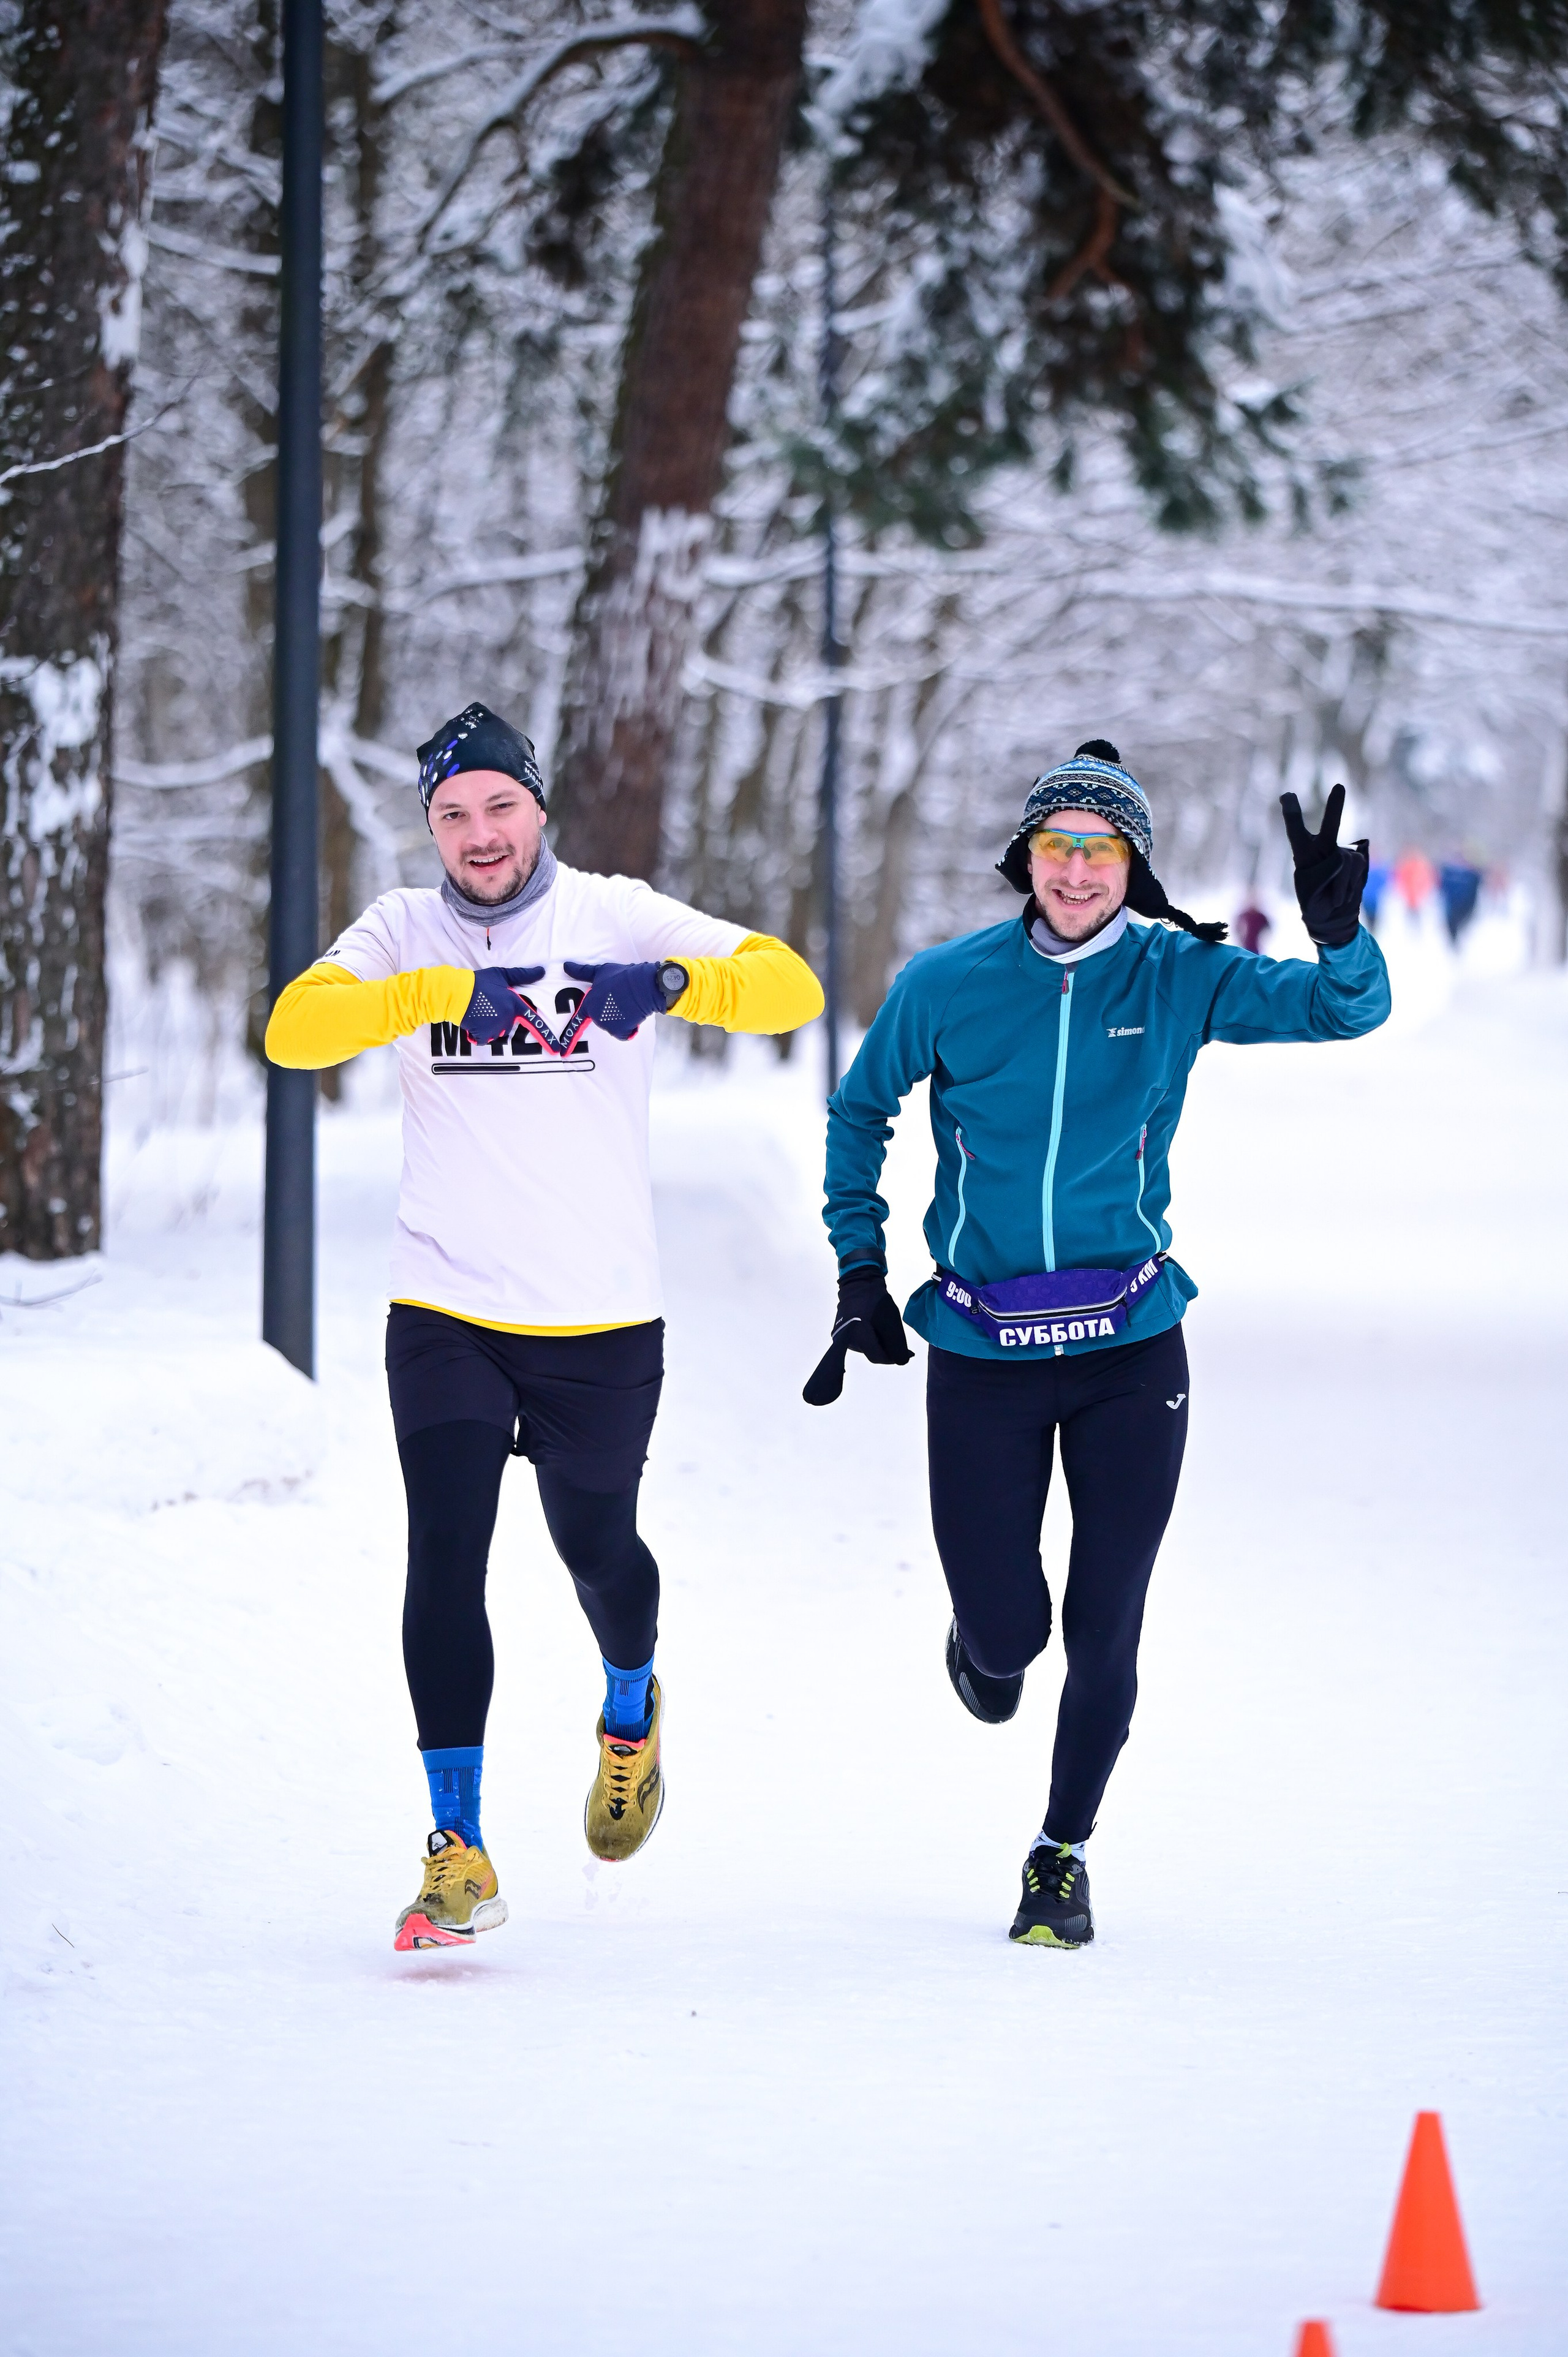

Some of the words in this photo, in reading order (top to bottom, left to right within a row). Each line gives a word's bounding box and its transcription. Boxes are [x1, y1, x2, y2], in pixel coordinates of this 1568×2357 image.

[524, 1009, 556, 1045] MOAX
[560, 1014, 583, 1049] MOAX
[946, 1281, 972, 1308] 9:00
[999, 1317, 1115, 1346] СУББОТА
